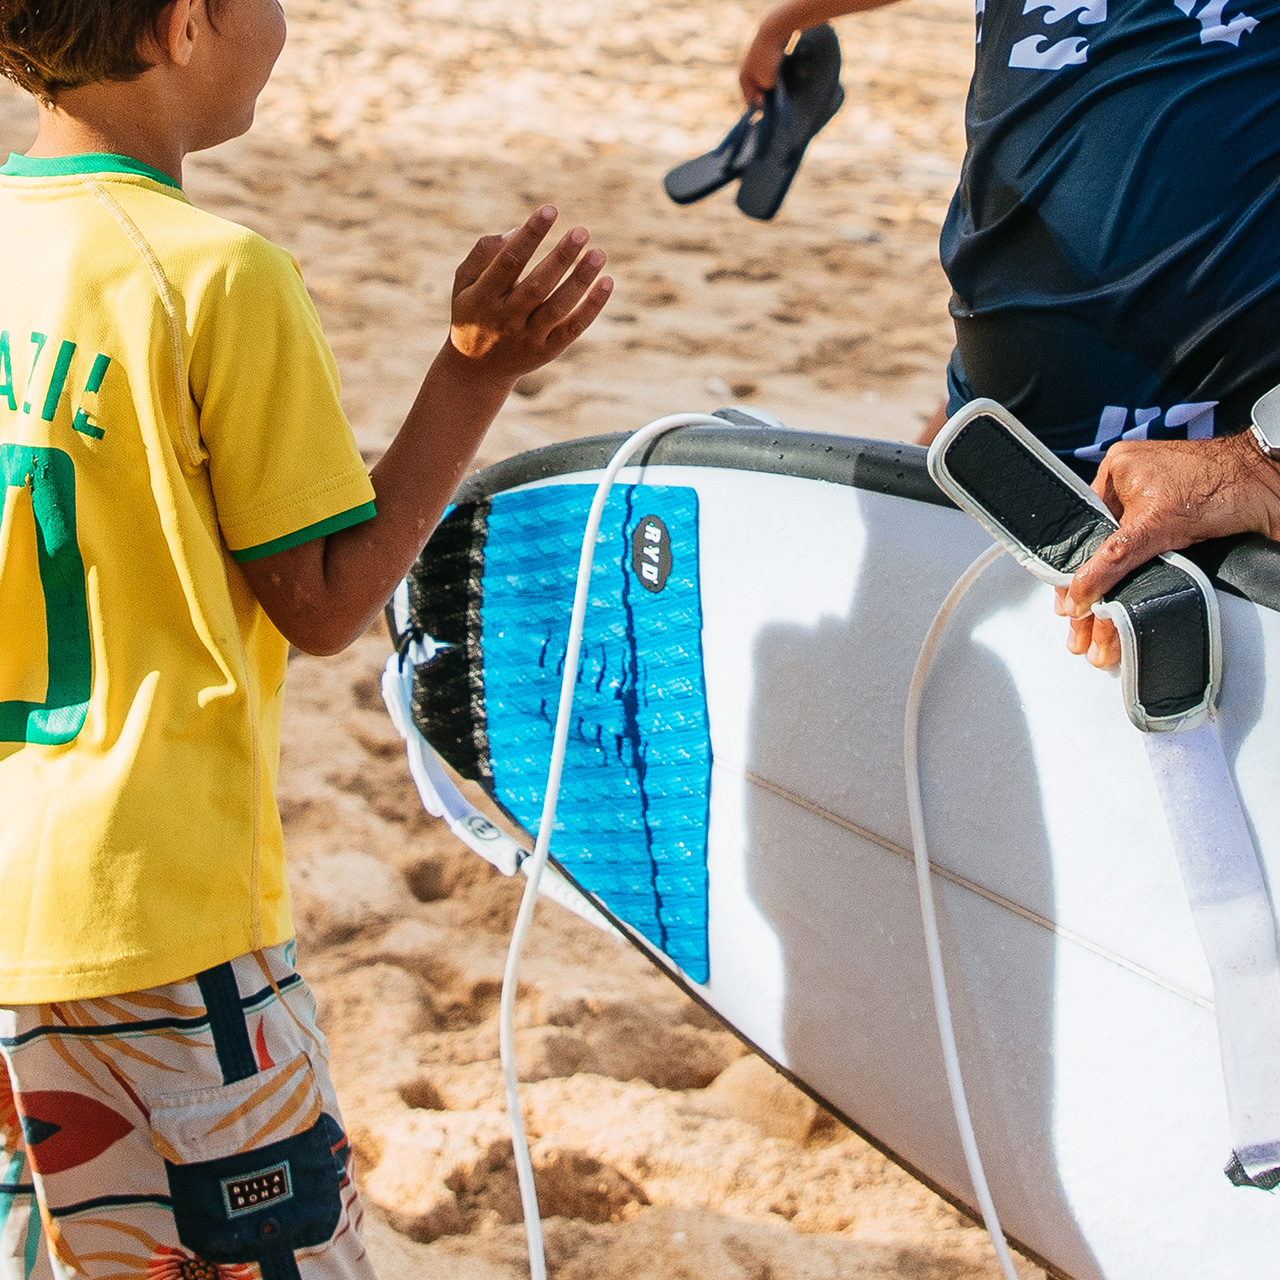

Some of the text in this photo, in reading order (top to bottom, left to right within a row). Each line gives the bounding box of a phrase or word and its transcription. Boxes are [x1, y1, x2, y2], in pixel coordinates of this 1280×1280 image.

[642, 523, 661, 584] RYD
[233, 1175, 281, 1195] BILLA
[237, 1185, 281, 1206] BONG
